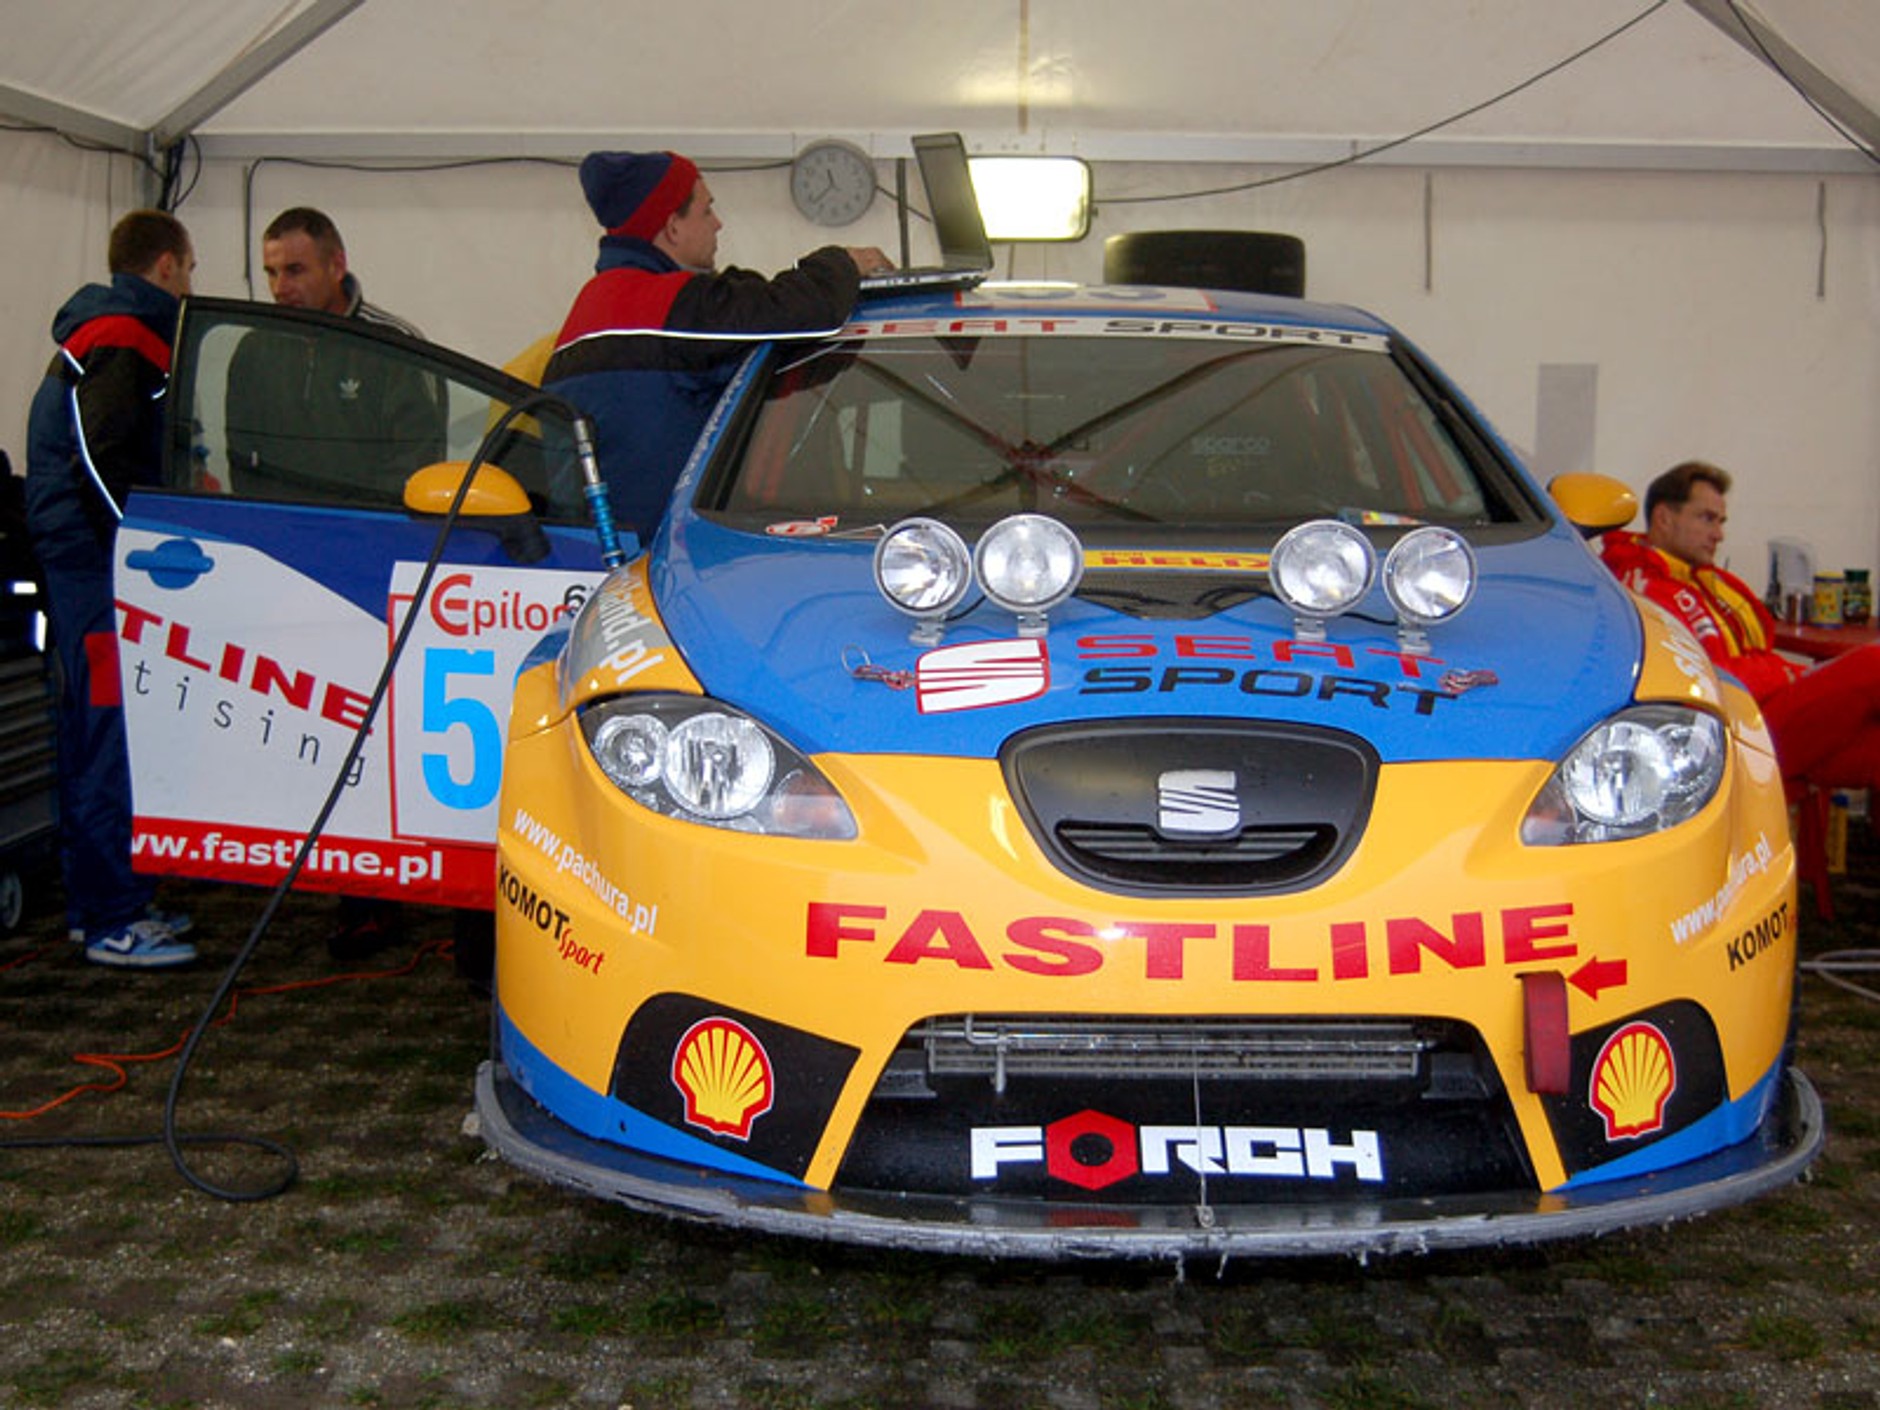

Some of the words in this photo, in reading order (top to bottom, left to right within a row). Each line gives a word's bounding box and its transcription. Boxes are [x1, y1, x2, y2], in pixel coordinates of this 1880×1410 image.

[1103, 320, 1368, 344] SPORT
[1076, 634, 1445, 680] SEAT
[1079, 666, 1460, 716] SPORT
[514, 808, 658, 936] www.pachura.pl
[499, 864, 570, 941] KOMOT
[557, 927, 605, 976] Sport
[807, 902, 1578, 982] FASTLINE
[1726, 902, 1788, 972] KOMOT
[970, 1108, 1384, 1191] FORCH
